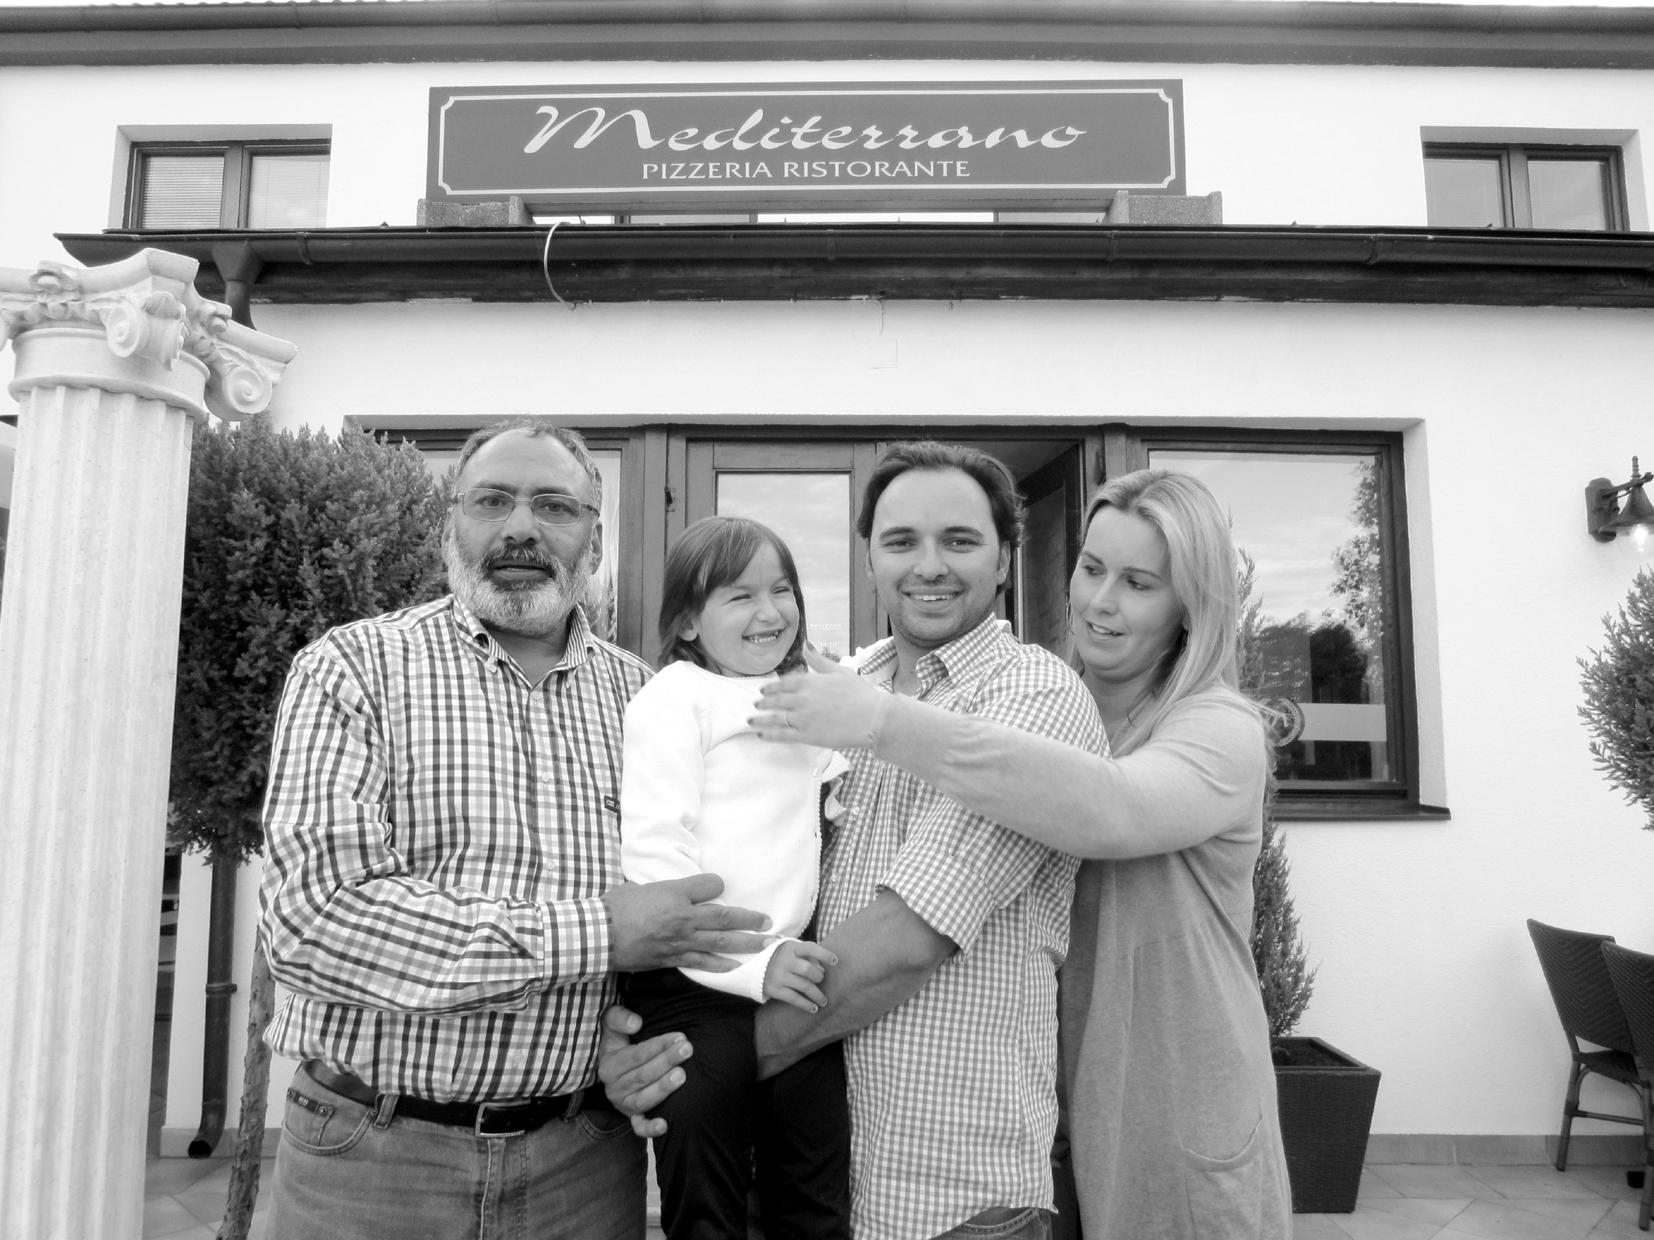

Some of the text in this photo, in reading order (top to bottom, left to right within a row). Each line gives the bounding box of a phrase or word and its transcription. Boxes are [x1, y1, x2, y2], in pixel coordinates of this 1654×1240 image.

[523, 105, 1088, 155] Mediterrano
[642, 160, 971, 180] PIZZERIA RISTORANTE
